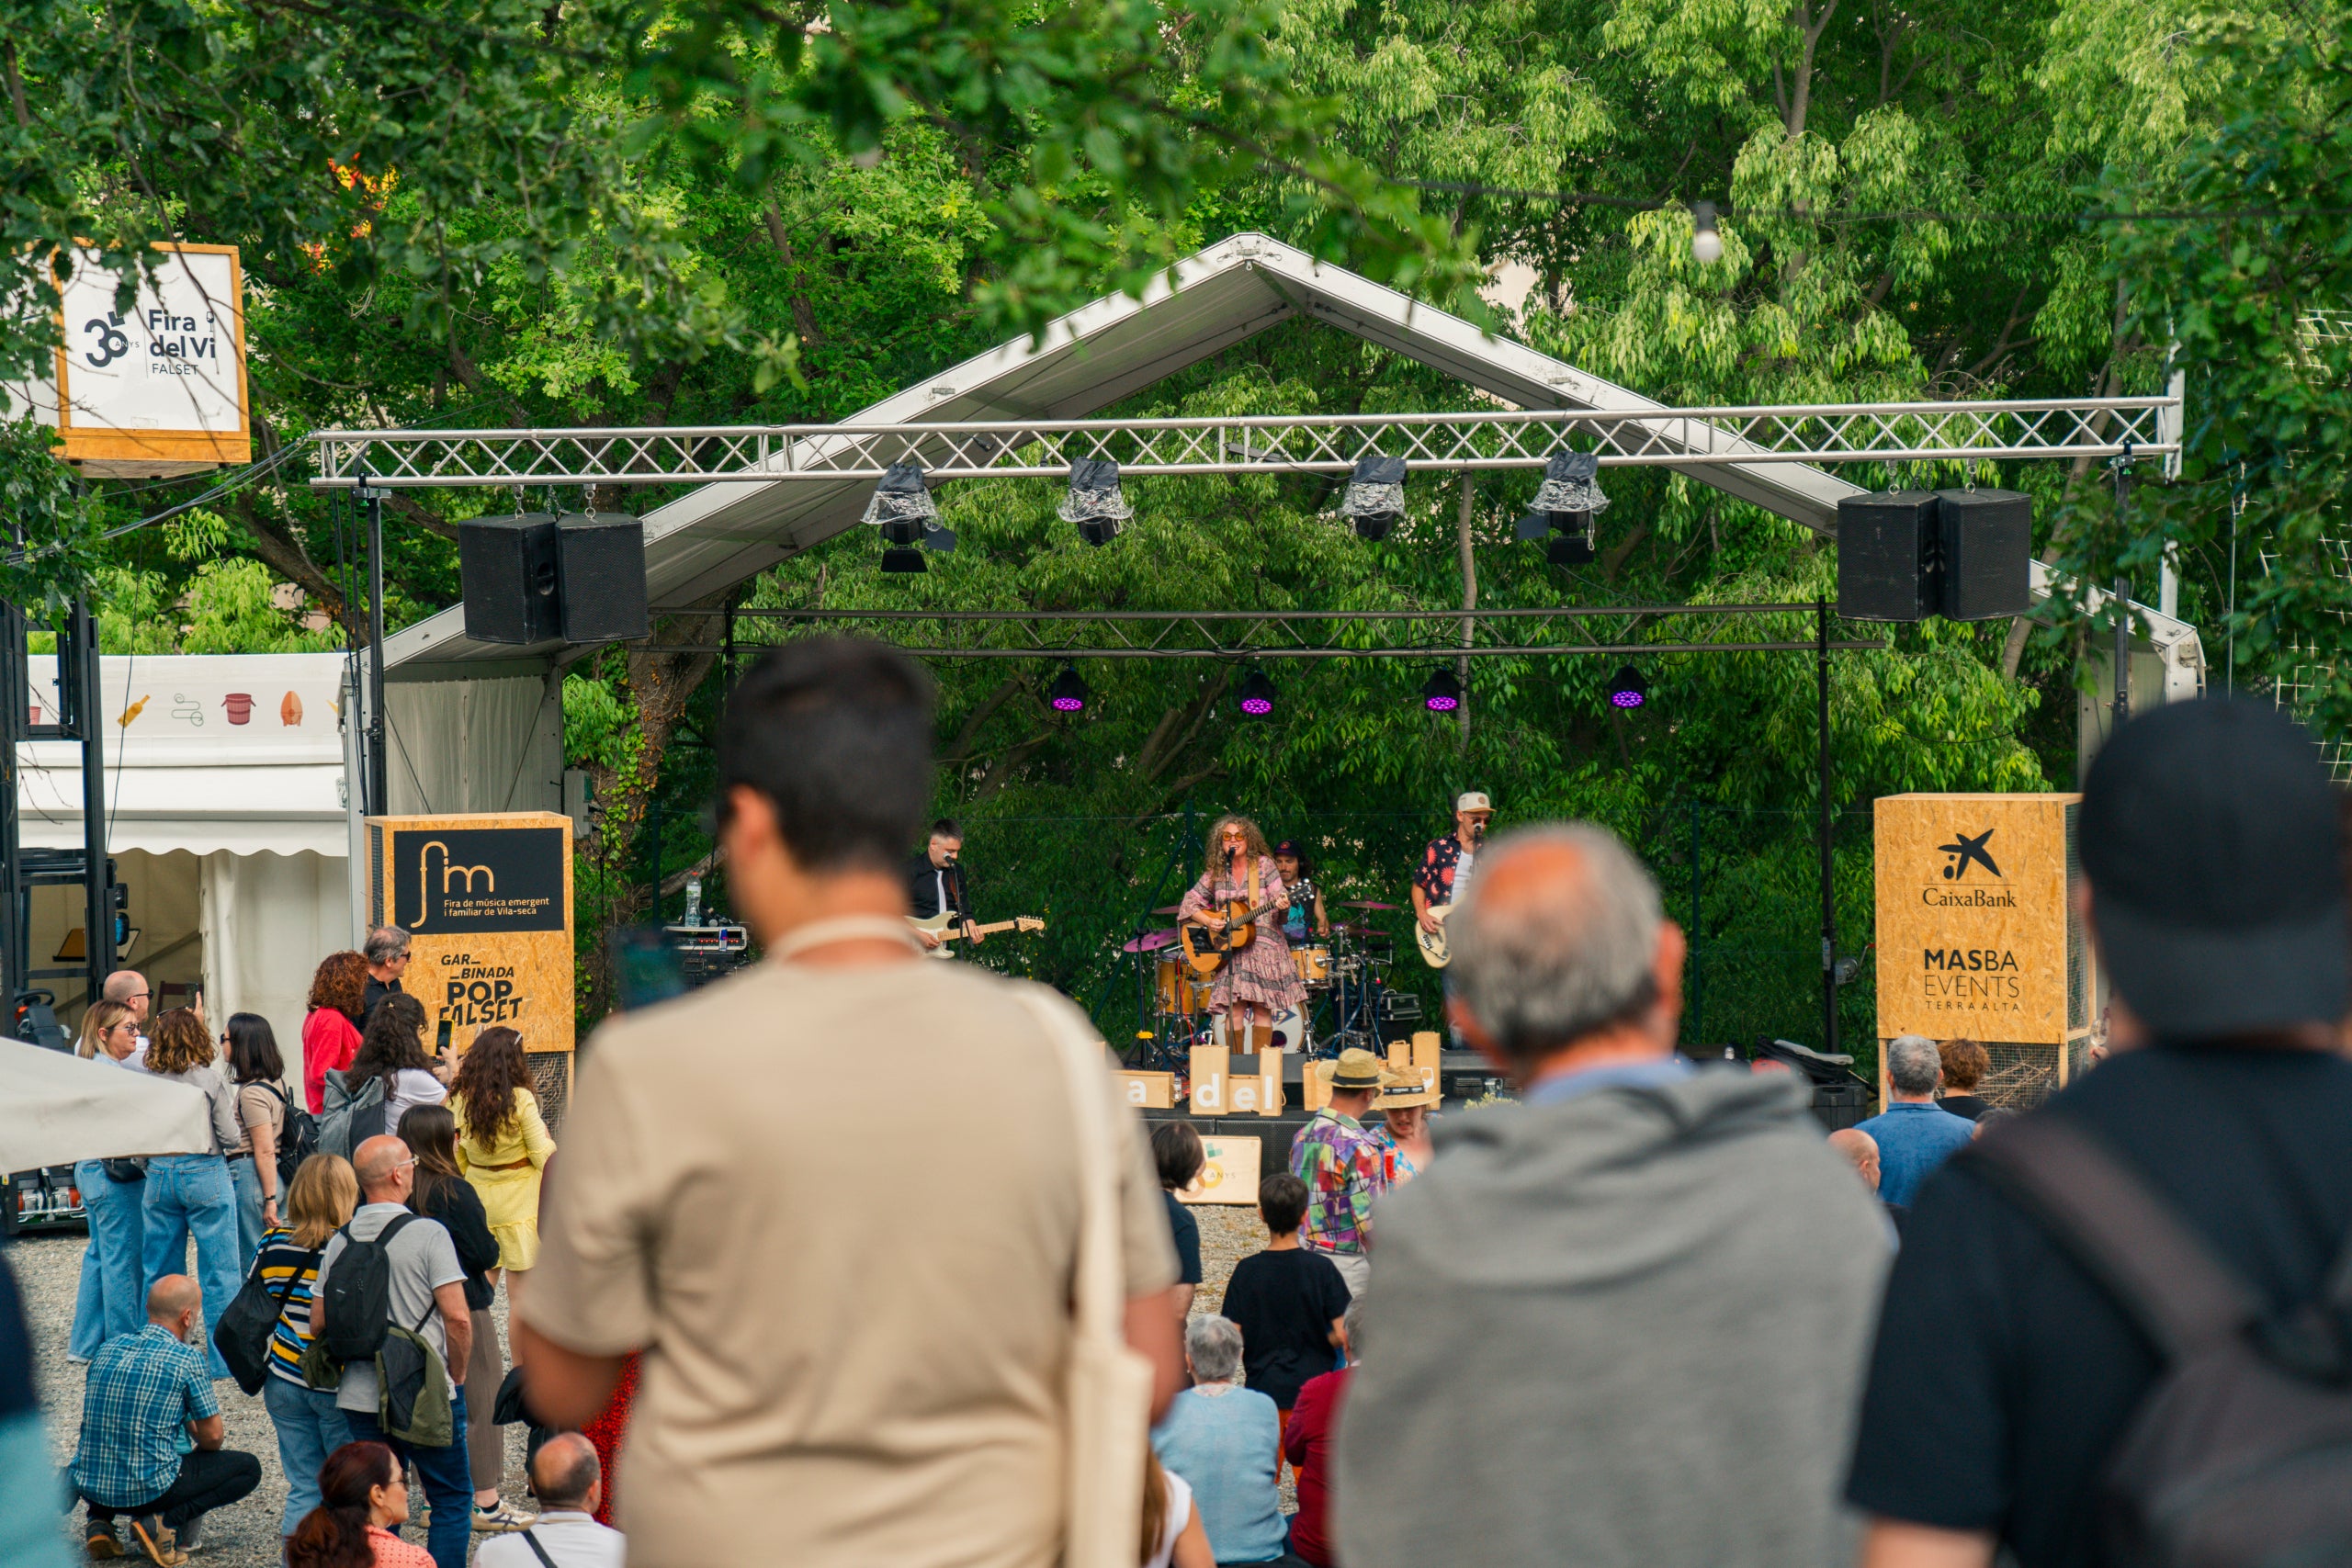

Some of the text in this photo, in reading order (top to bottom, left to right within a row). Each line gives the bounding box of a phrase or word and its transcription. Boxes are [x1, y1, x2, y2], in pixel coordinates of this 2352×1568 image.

[148, 310, 197, 332] Fira
[150, 334, 216, 358] del Vi
[152, 363, 199, 376] FALSET
[444, 897, 549, 908] Fira de música emergent
[1922, 887, 2018, 908] CaixaBank
[444, 907, 537, 917] i familiar de Vila-seca
[1924, 948, 2019, 972] MASBA
[447, 980, 514, 1006] POP
[1925, 975, 2019, 998] EVENTS
[1925, 1000, 2020, 1011] TERRA ALTA
[1196, 1073, 1273, 1112] del
[1210, 1171, 1237, 1179] ANYS
